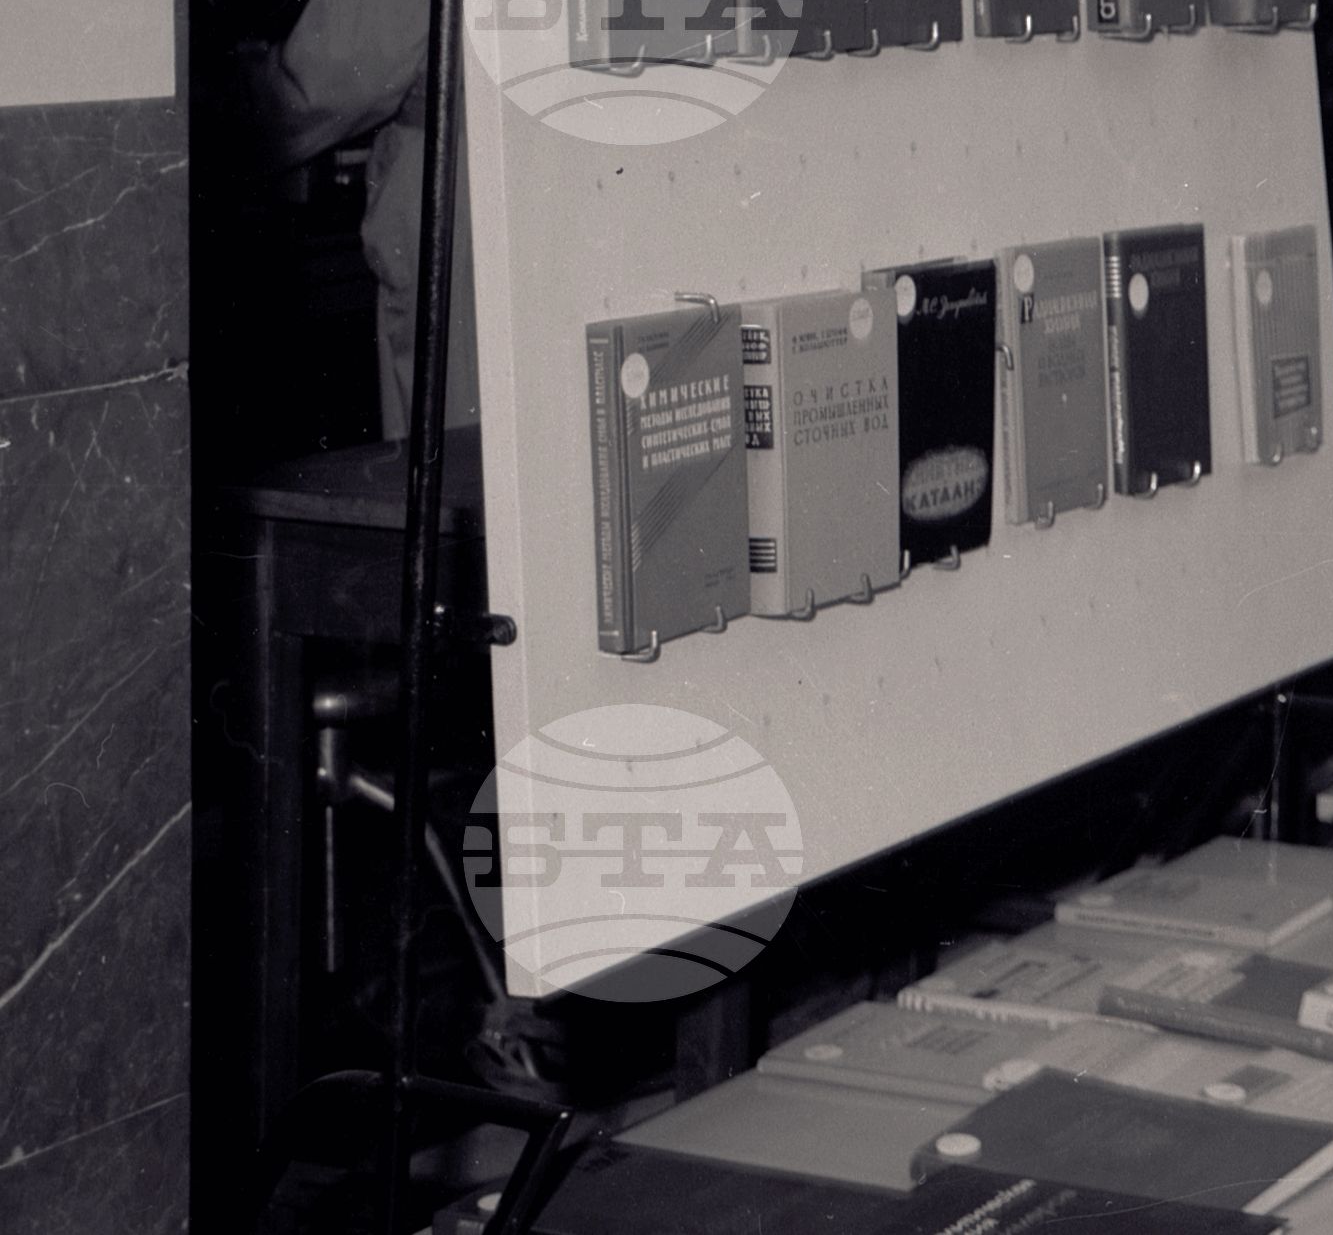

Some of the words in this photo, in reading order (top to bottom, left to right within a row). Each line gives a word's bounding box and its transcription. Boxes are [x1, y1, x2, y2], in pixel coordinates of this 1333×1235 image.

[640, 373, 730, 410] ХИМИЧЕСКИЕ
[793, 377, 889, 406] ОЧИСТКА
[794, 394, 889, 425] ПРОМЫШЛЕННЫХ
[793, 421, 856, 446] СТОЧНЫХ
